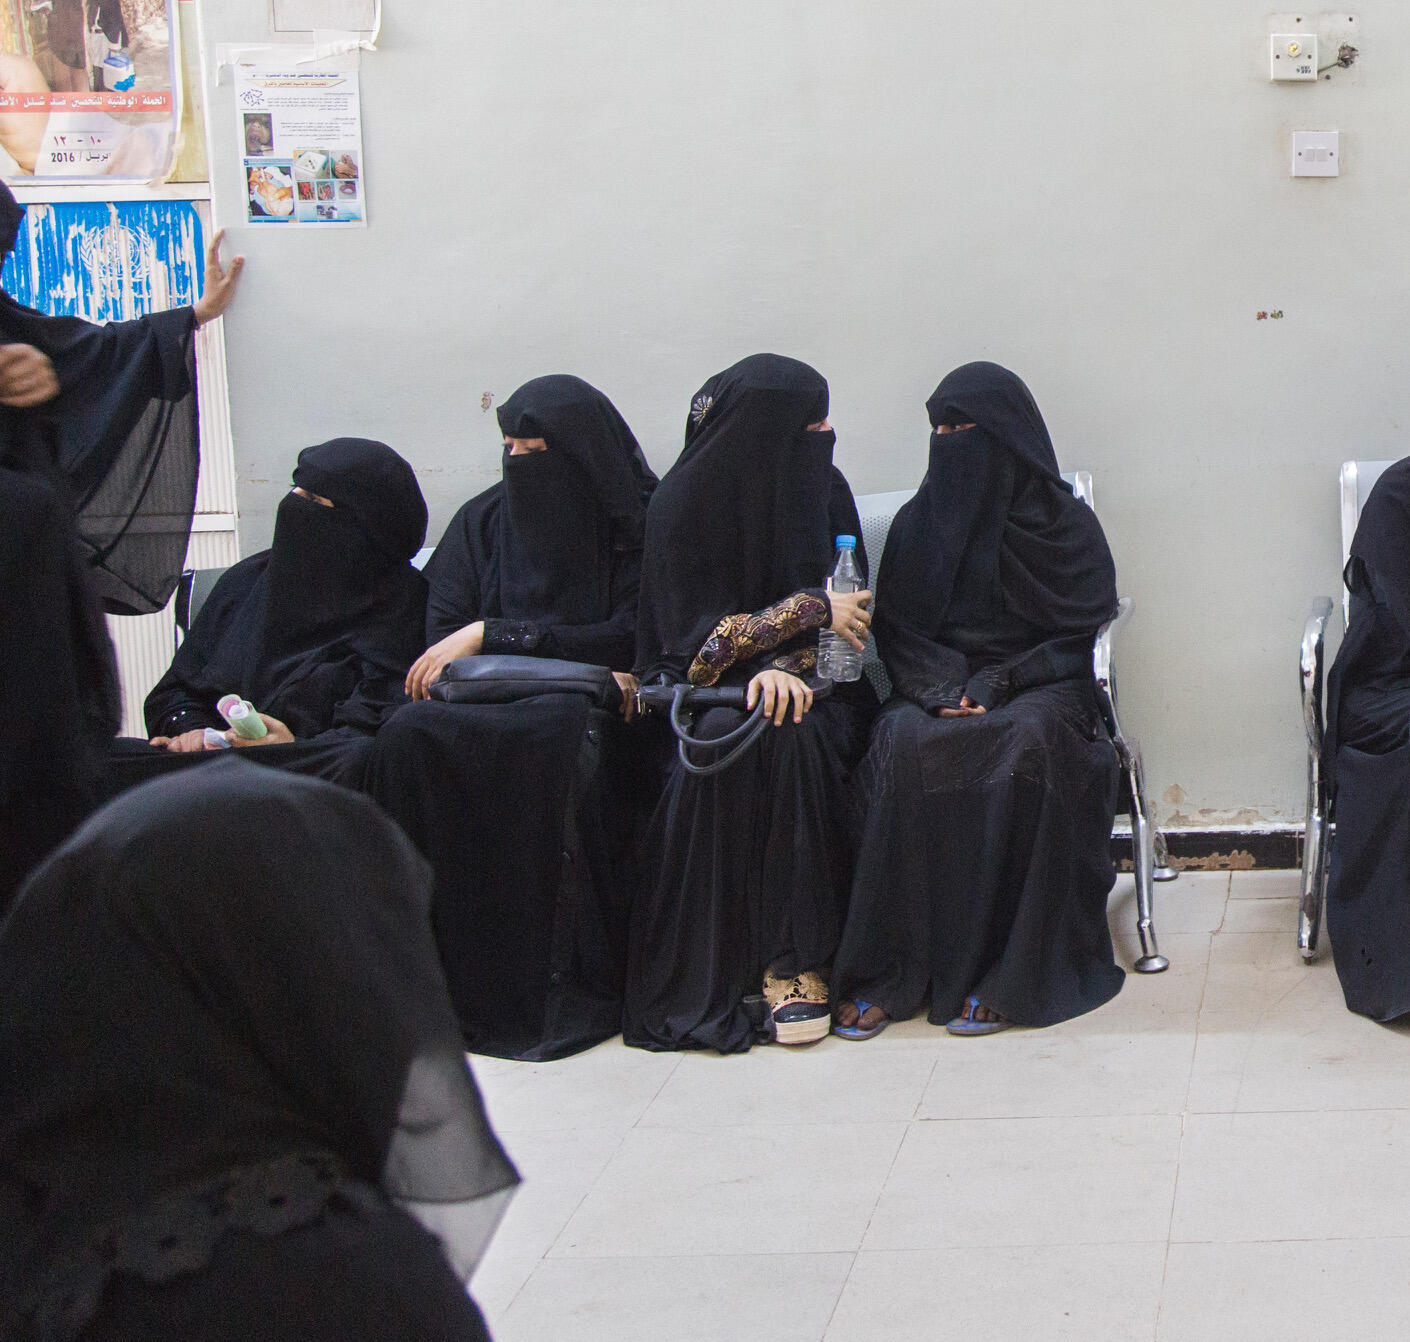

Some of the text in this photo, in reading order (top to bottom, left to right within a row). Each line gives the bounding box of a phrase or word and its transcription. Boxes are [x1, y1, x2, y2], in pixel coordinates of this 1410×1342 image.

[23, 94, 45, 108] شلل
[50, 95, 67, 106] ضد
[71, 95, 103, 108] للتحصين
[107, 95, 138, 108] الوطنية
[142, 95, 167, 106] الحملة
[51, 151, 75, 163] 2016
